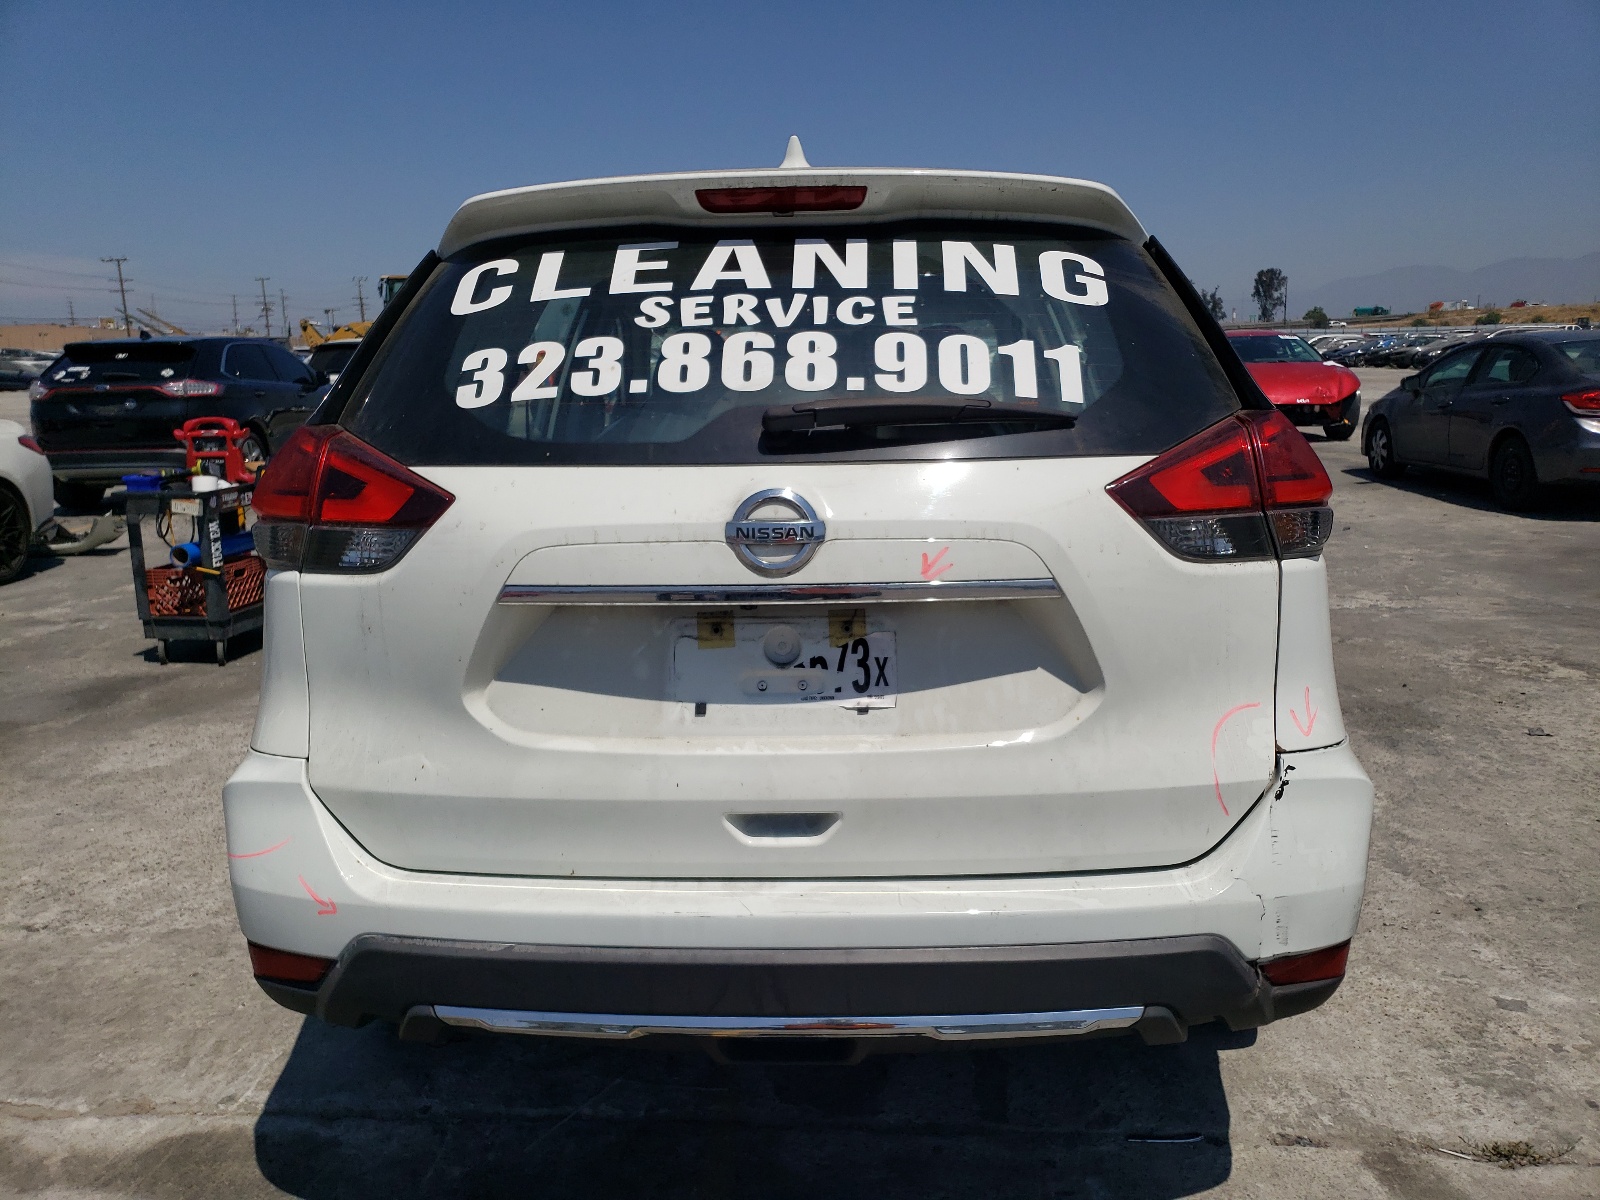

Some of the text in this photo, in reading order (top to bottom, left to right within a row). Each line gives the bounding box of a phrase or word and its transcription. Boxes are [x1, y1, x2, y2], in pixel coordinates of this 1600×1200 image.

[450, 238, 1109, 316] CLEANING
[634, 294, 919, 328] SERVICE
[455, 331, 1084, 409] 323.868.9011
[735, 526, 815, 540] NISSAN
